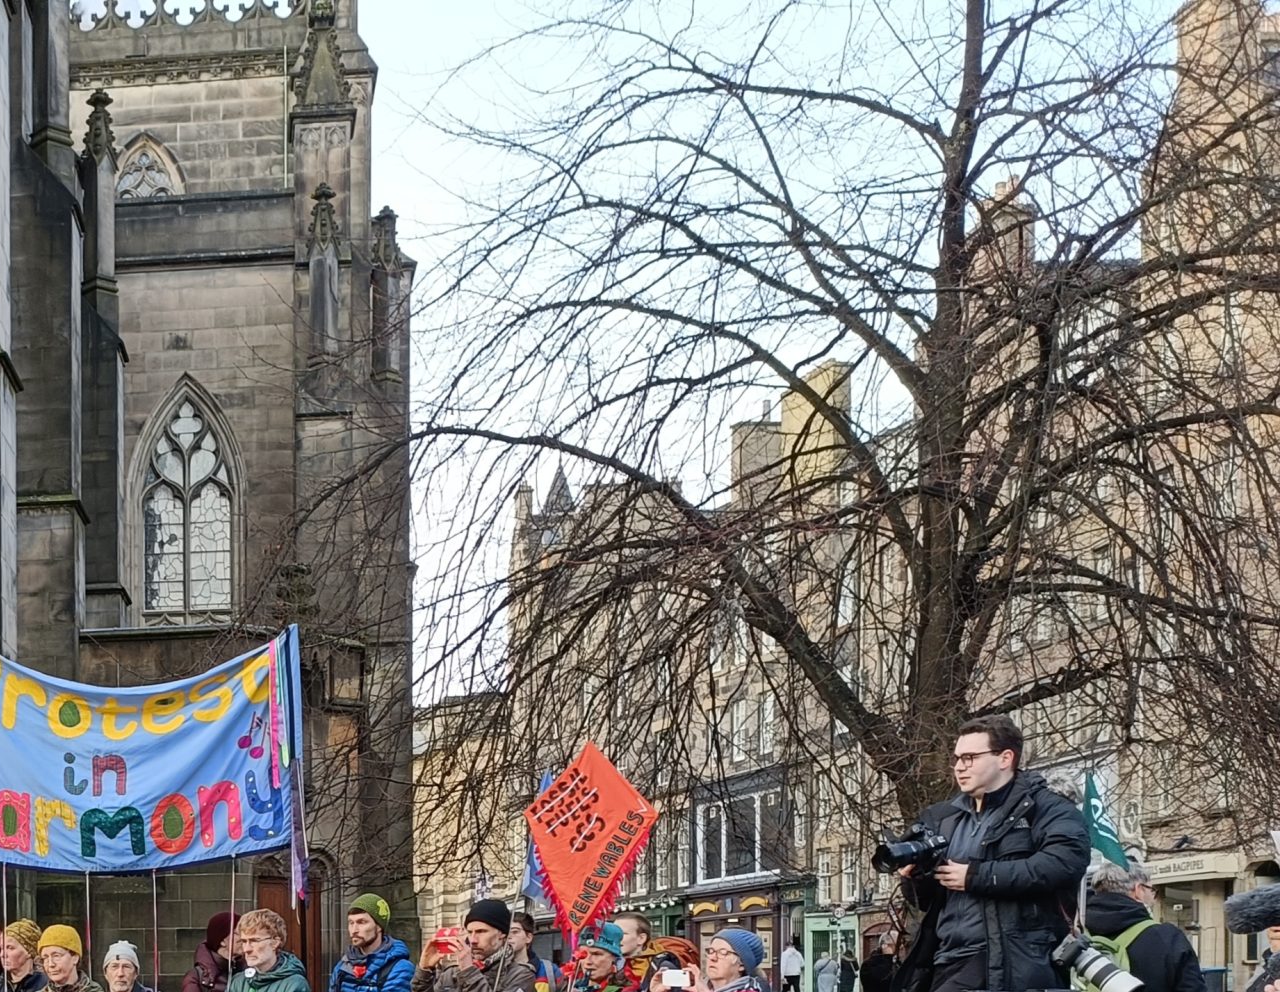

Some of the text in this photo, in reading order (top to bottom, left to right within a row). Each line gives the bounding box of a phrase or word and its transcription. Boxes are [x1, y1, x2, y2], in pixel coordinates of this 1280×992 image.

[64, 752, 127, 797] in
[530, 768, 587, 824] FOSSIL
[545, 786, 600, 838] FUELS
[570, 812, 606, 853] CCS
[568, 810, 645, 927] RENEWABLES
[1172, 859, 1204, 873] BAGPIPES
